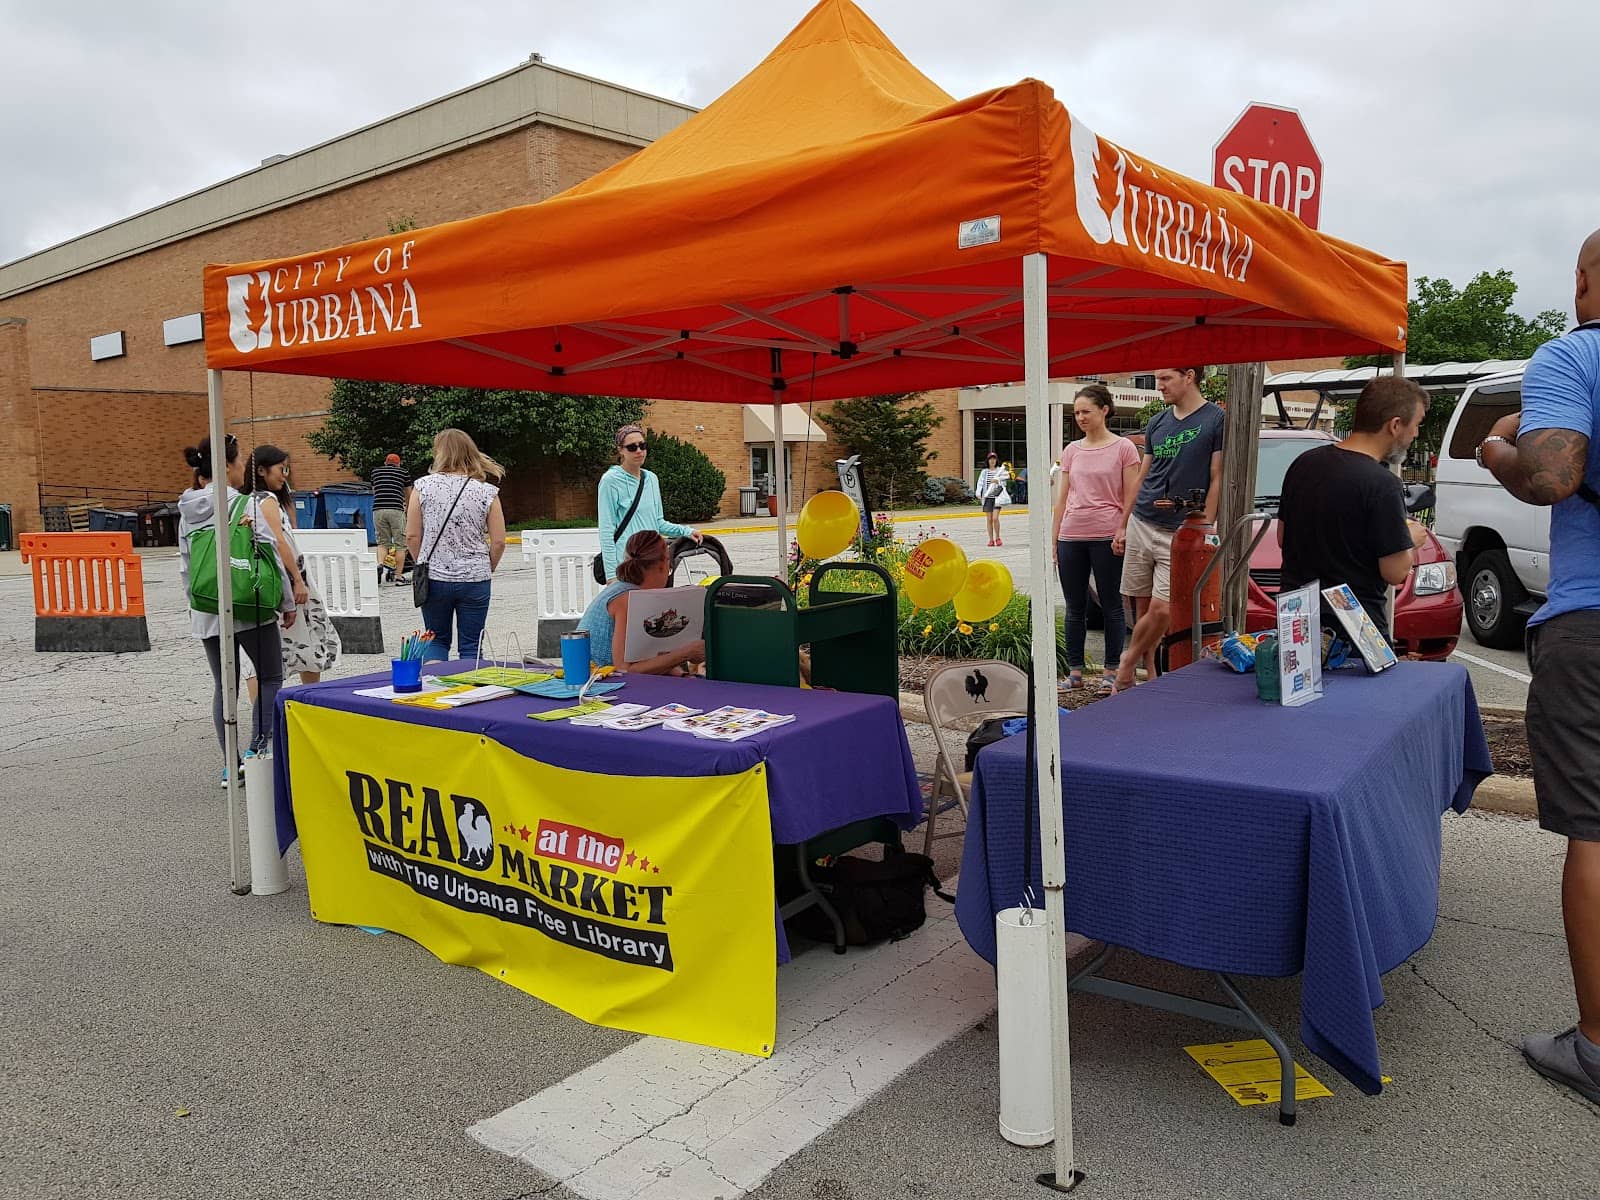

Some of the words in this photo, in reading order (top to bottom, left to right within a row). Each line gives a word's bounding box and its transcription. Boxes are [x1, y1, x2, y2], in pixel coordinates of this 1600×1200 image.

[1222, 155, 1316, 219] STOP
[273, 256, 351, 293] CITY
[374, 240, 415, 275] OF
[1128, 184, 1253, 283] URBANA
[276, 278, 422, 347] URBANA
[346, 770, 495, 872] READ
[538, 827, 568, 854] at
[576, 833, 623, 867] the
[368, 847, 403, 876] with
[402, 861, 440, 891] The
[444, 873, 520, 916] Urbana
[525, 897, 568, 936] Free
[573, 920, 666, 964] Library
[500, 843, 673, 926] MARKET
